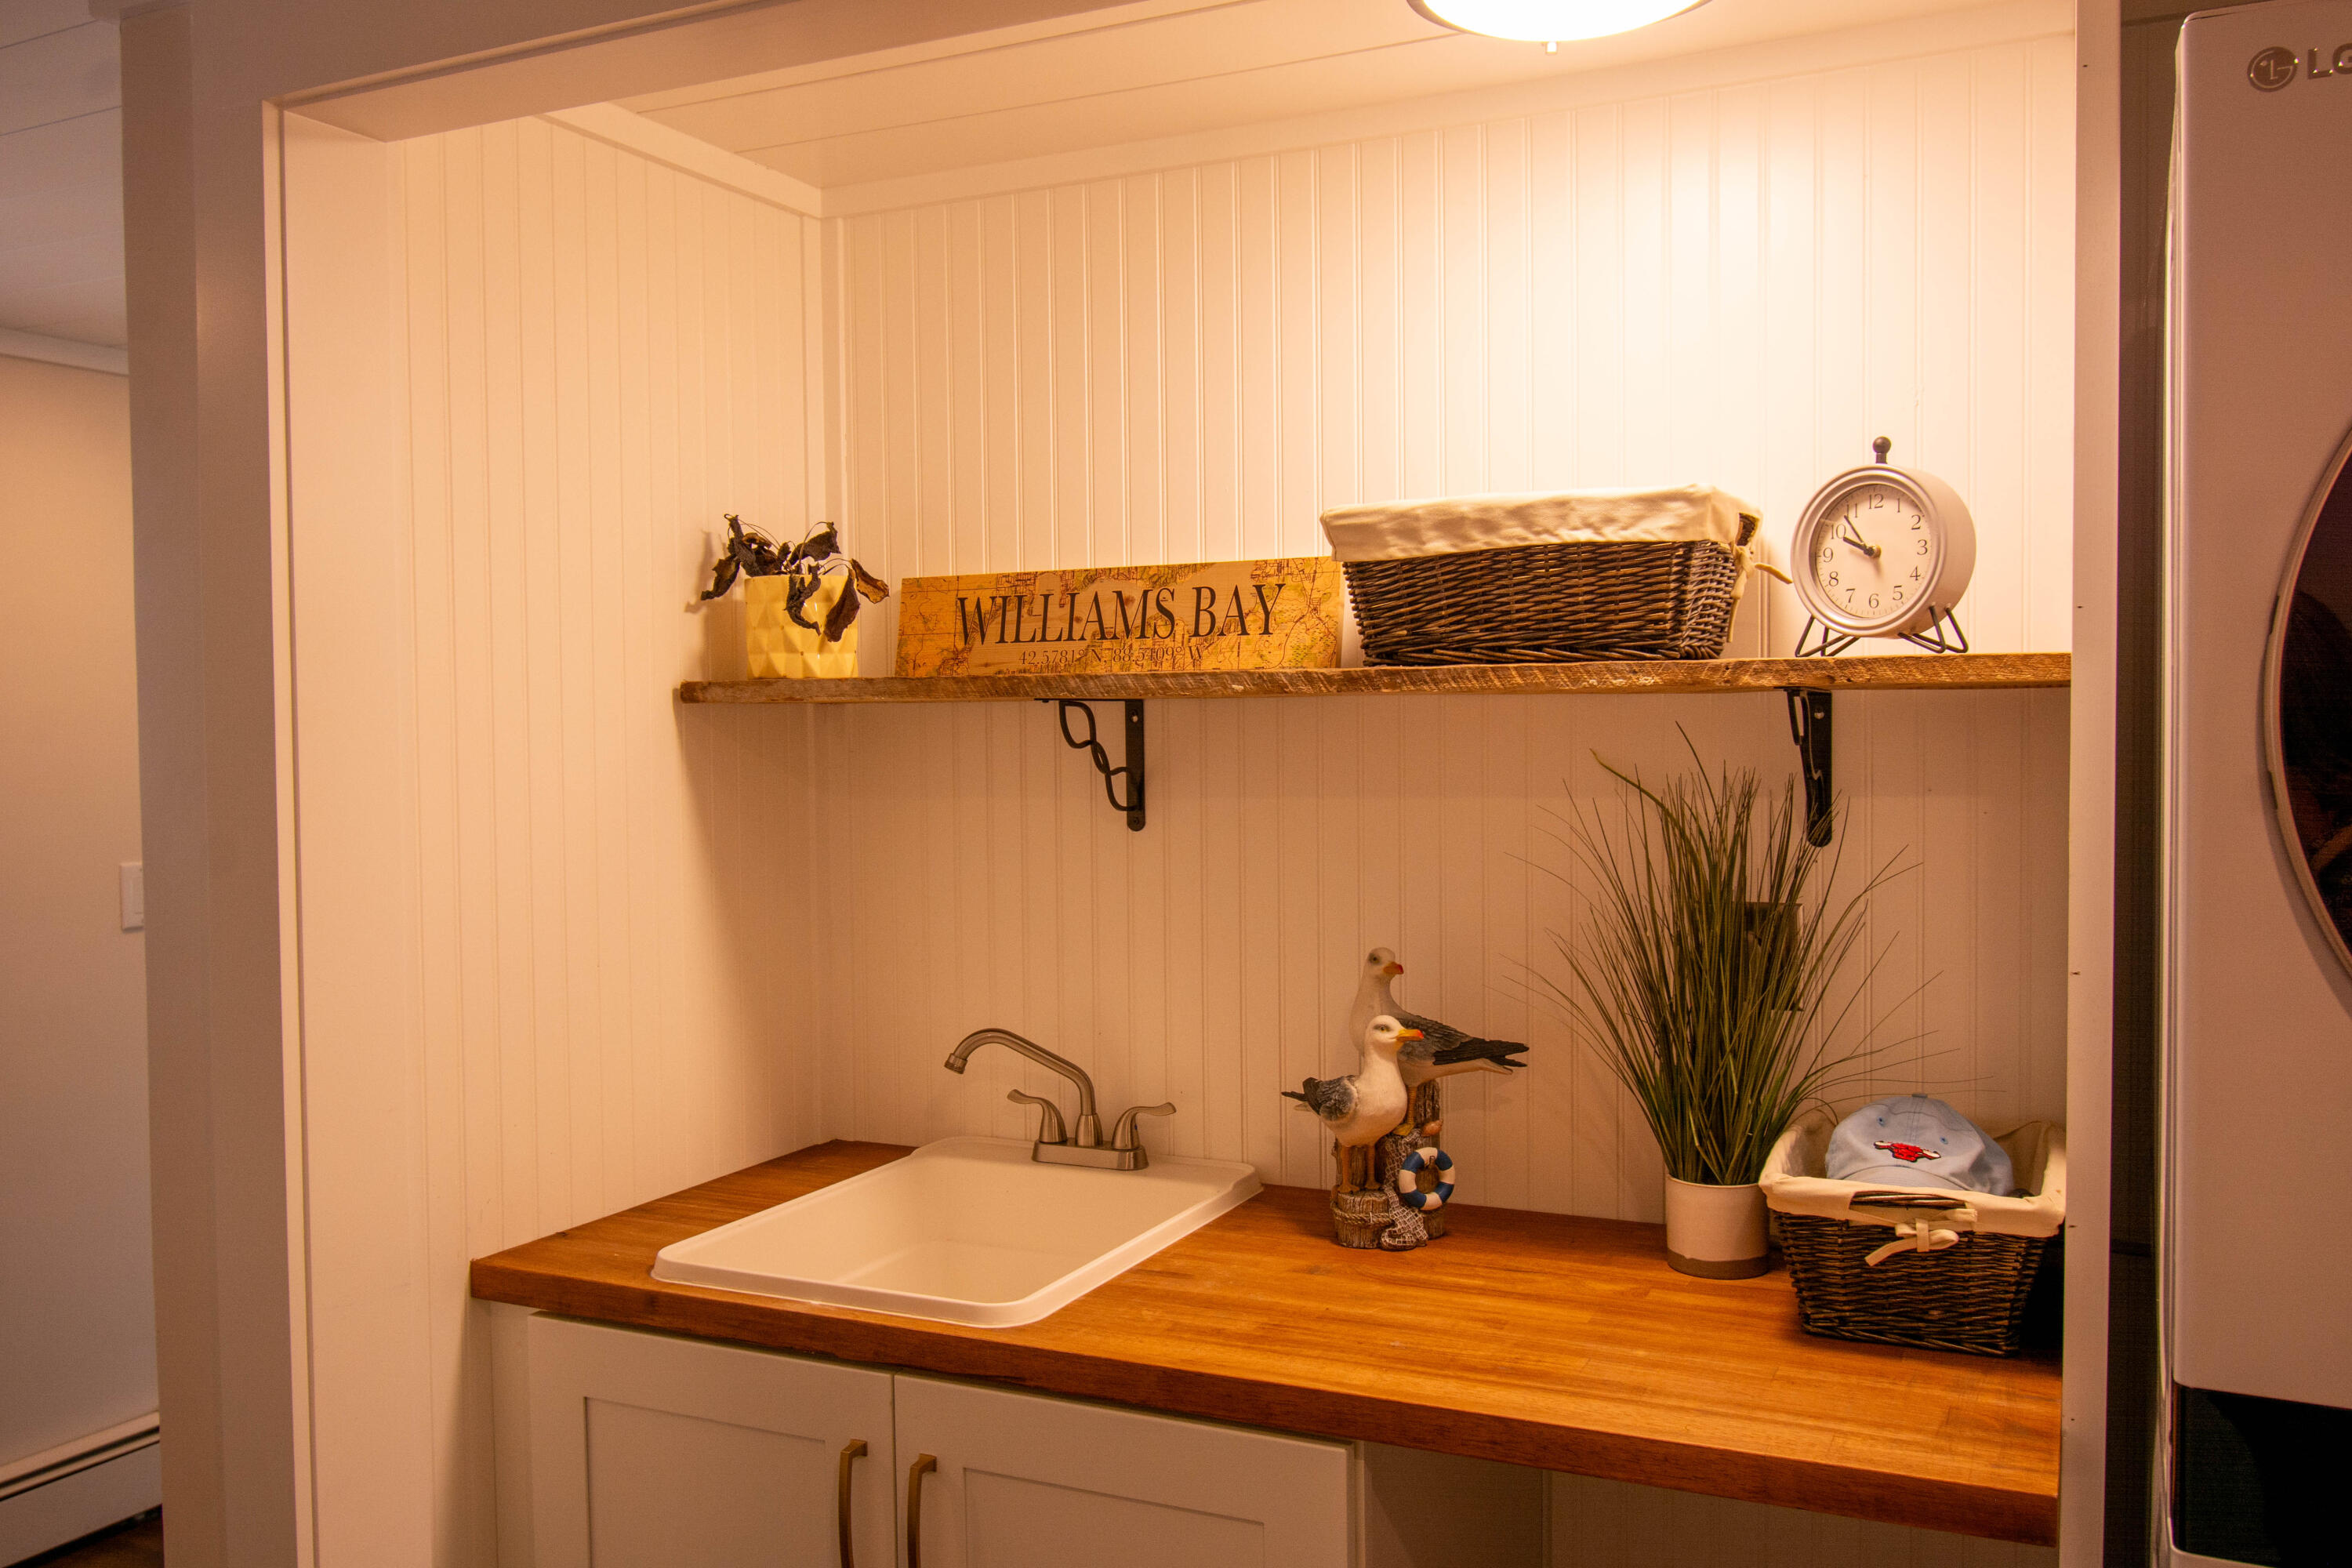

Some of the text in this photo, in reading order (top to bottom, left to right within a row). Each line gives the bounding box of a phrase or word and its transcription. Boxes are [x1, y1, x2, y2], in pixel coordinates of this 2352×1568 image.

[2307, 42, 2352, 80] LG
[1868, 493, 1884, 510] 12
[1896, 498, 1901, 513] 1
[1846, 503, 1858, 518] 11
[1911, 514, 1921, 530] 2
[1830, 524, 1846, 539] 10
[1823, 546, 1833, 563] 9
[1917, 539, 1928, 555] 3
[1828, 571, 1838, 587] 8
[1910, 565, 1921, 581] 4
[1846, 588, 1856, 603] 7
[1868, 593, 1879, 608] 6
[1893, 585, 1903, 601] 5
[957, 583, 1286, 646] WILLIAMS BAY
[1018, 648, 1085, 665] 42.5781°
[1091, 648, 1107, 664] N,
[1188, 645, 1206, 661] W
